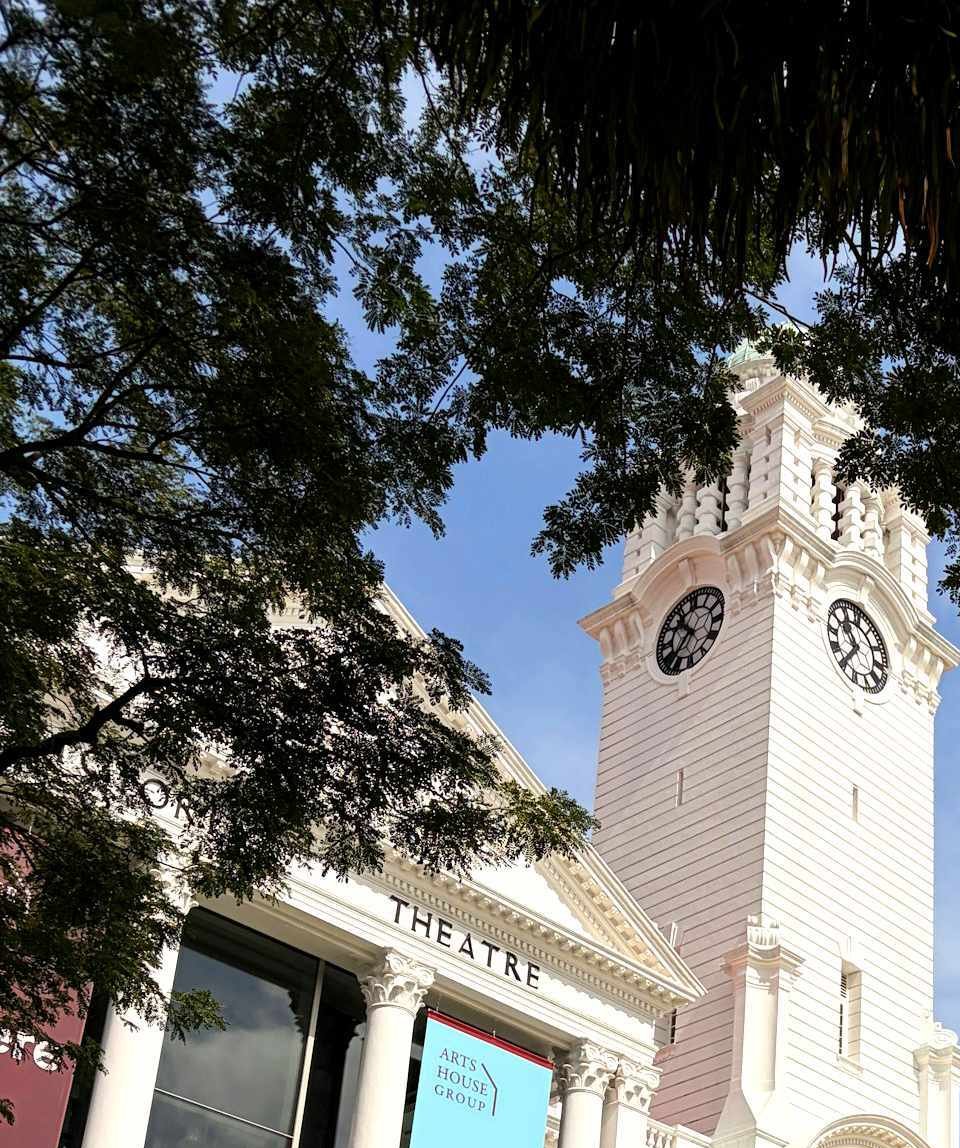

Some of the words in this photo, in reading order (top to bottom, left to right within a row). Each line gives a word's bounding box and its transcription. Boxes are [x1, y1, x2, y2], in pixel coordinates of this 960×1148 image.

[389, 895, 540, 989] THEATRE
[439, 1048, 477, 1071] ARTS
[437, 1065, 488, 1096] HOUSE
[434, 1084, 486, 1111] GROUP
